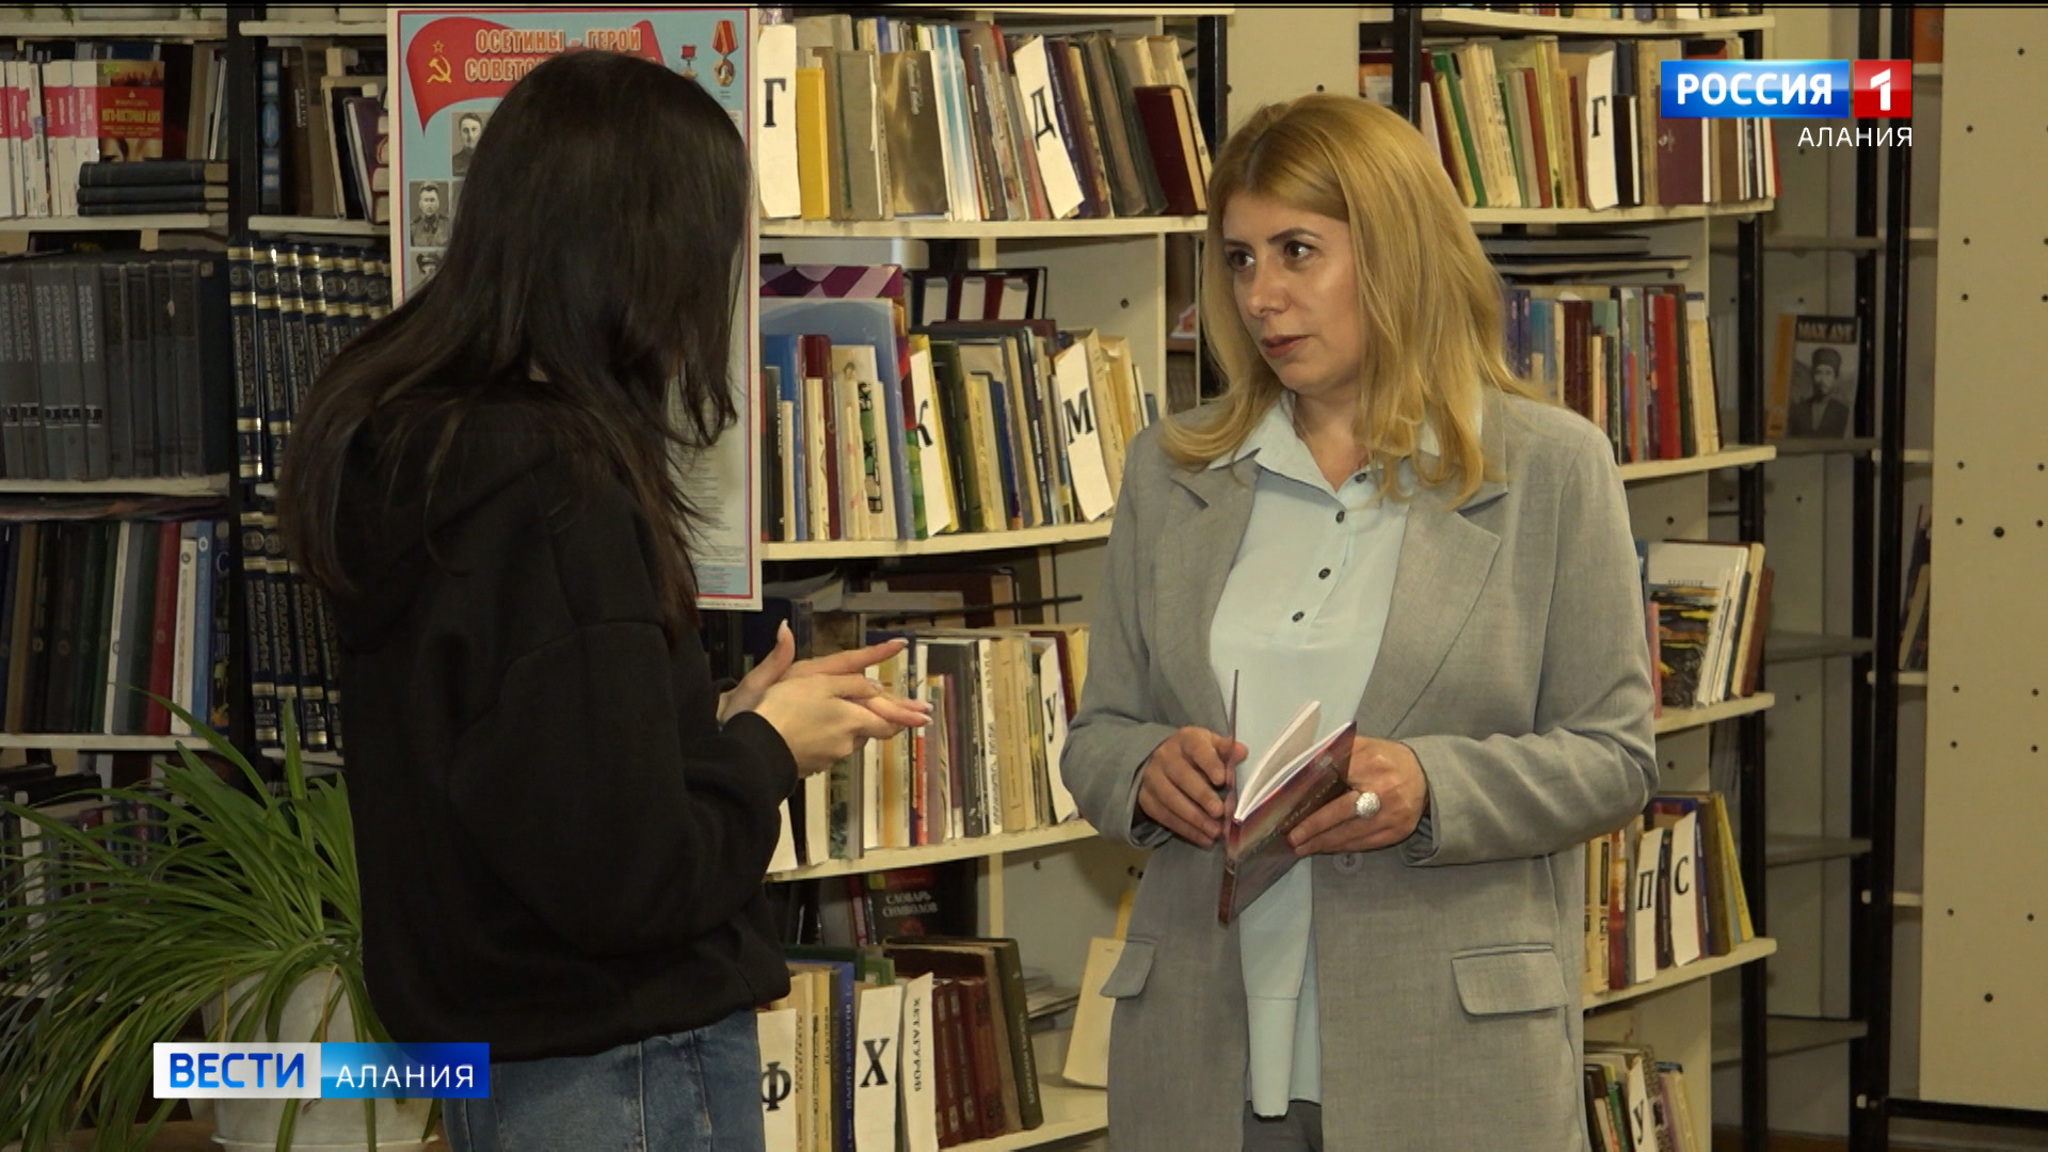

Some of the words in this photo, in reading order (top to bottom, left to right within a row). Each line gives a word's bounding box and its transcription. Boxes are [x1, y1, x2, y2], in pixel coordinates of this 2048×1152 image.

[476, 28, 565, 53] ОСЕТИНЫ
[763, 77, 787, 128] Г
[1030, 85, 1057, 151] Д
[1591, 95, 1607, 138] Г
[1062, 388, 1094, 444] М
[1045, 691, 1057, 744] У
[1636, 869, 1657, 912] П
[1674, 855, 1690, 896] С
[859, 1037, 891, 1088] Х
[912, 997, 922, 1092] ХЕТАГУРОВ
[761, 1061, 791, 1111] Ф
[1632, 1099, 1645, 1145] У
